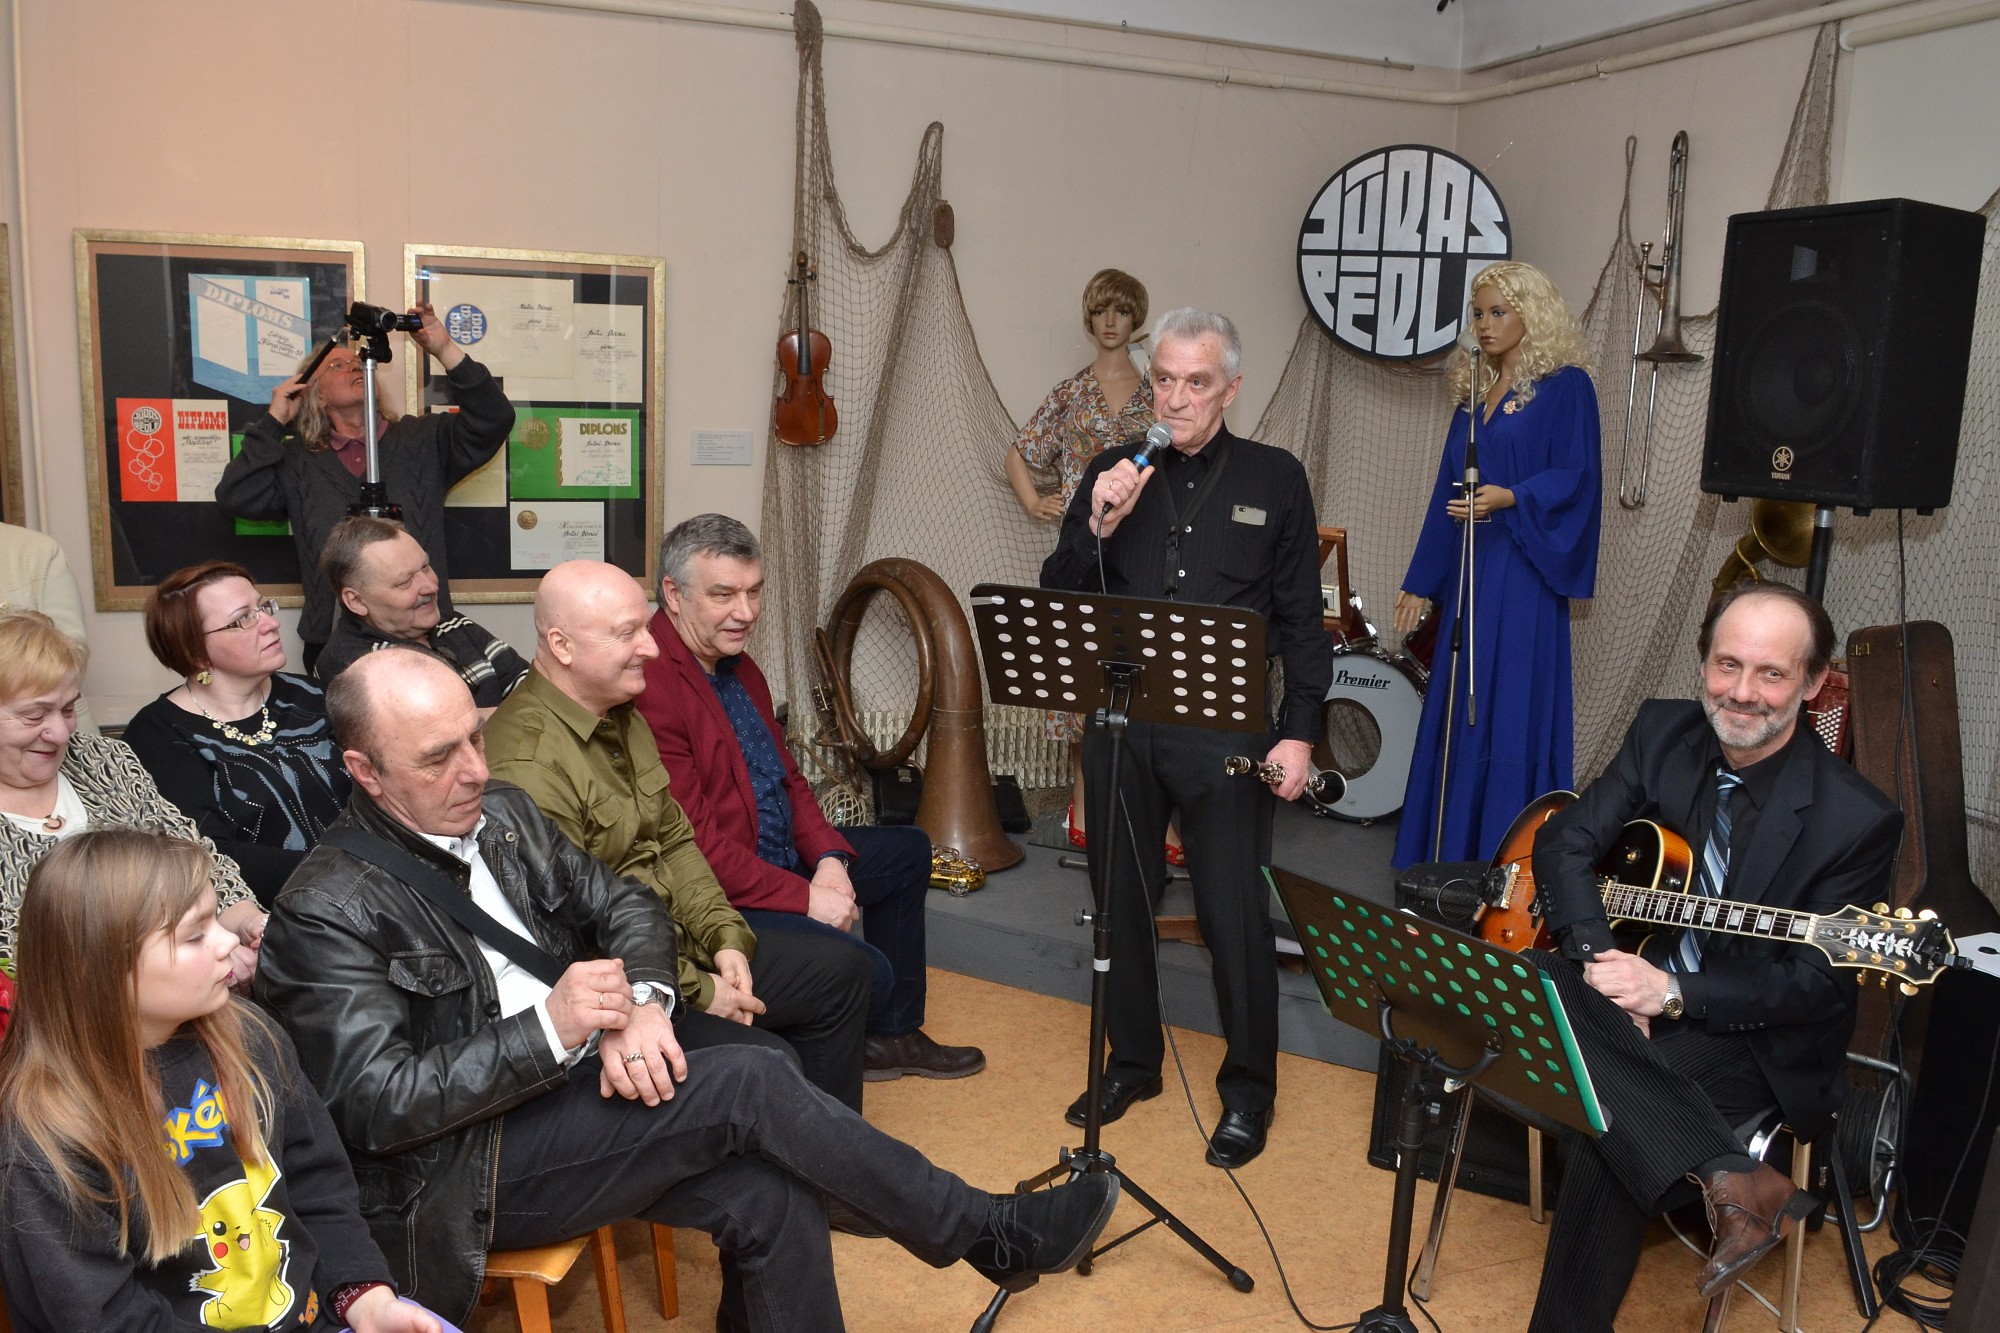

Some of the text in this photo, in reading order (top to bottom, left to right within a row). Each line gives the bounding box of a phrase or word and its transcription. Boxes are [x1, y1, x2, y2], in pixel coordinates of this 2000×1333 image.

[1301, 148, 1508, 254] JŪRAS
[203, 282, 295, 329] DIPLOMS
[177, 410, 227, 431] DIPLOMS
[579, 422, 628, 436] DIPLOMS
[1771, 472, 1790, 481] YAMAHA
[1335, 669, 1391, 689] Premier
